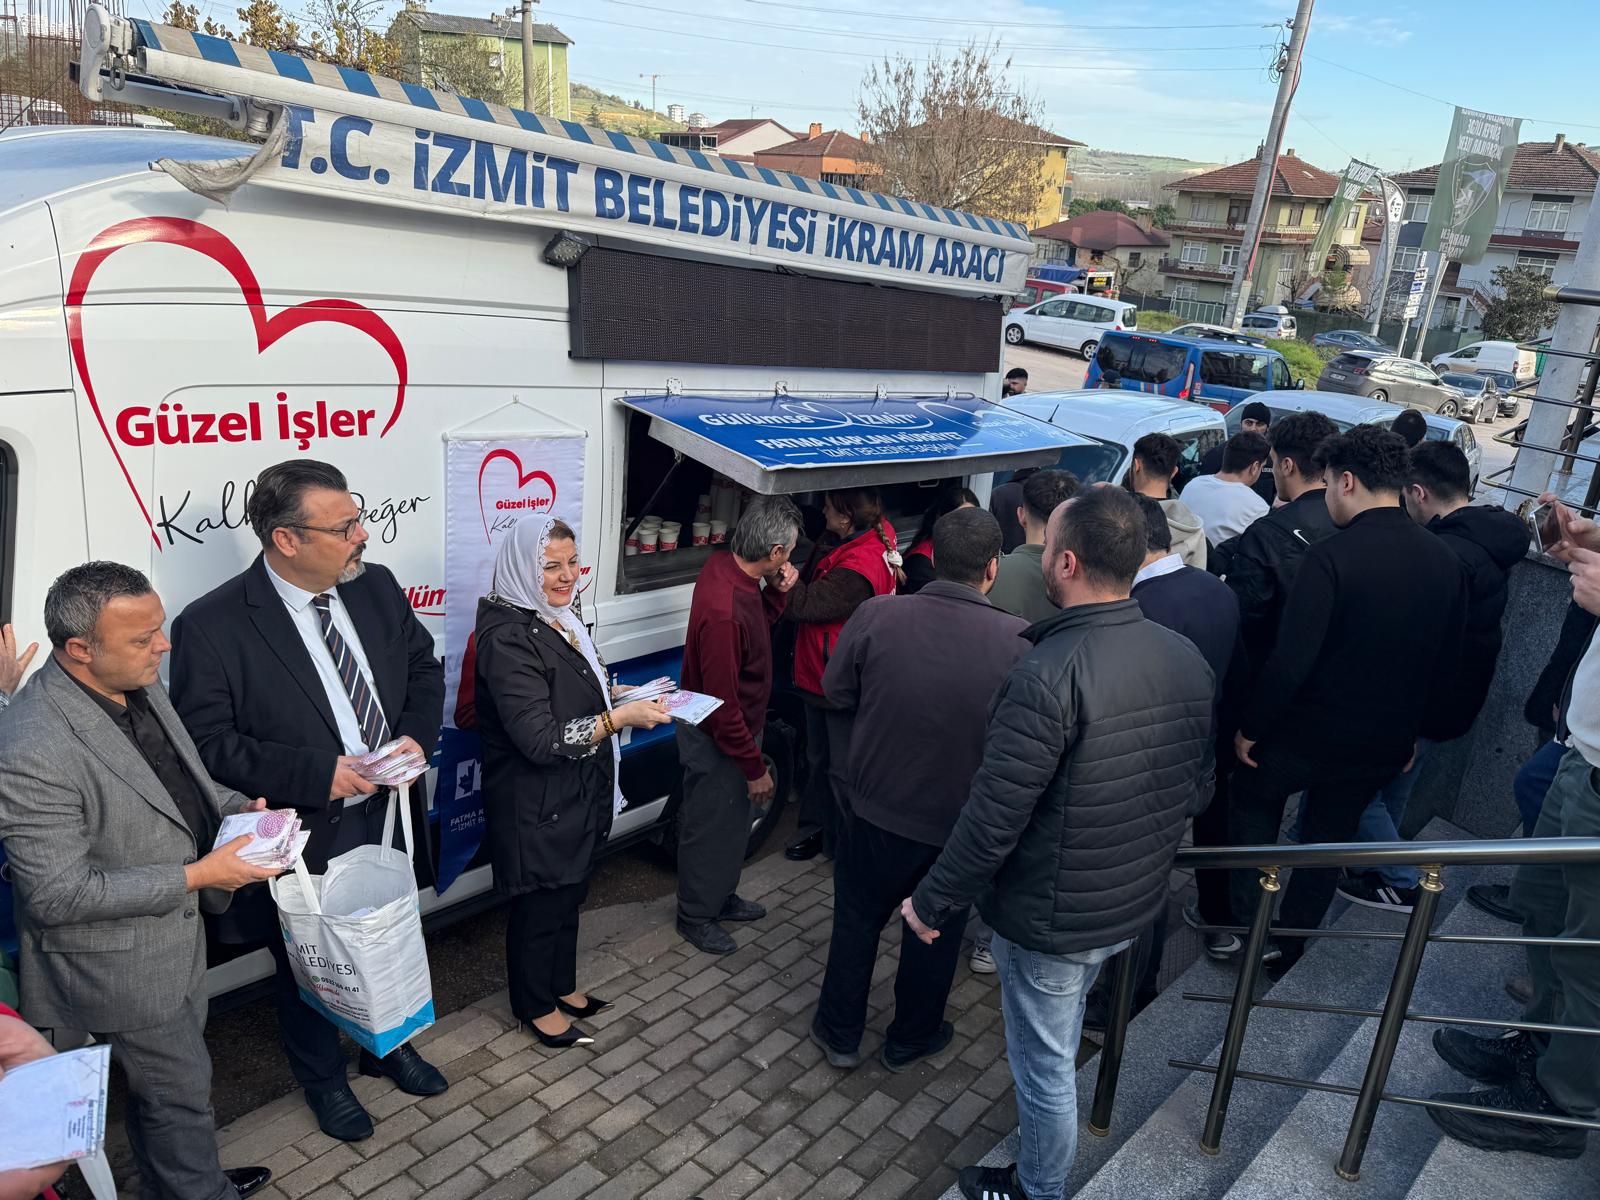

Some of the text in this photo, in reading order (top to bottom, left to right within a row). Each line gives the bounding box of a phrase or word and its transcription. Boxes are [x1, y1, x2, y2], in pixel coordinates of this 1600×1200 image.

[282, 107, 1005, 284] T.C. İZMİT BELEDİYESİ İKRAM ARACI
[115, 392, 376, 451] Güzel İşler
[698, 412, 816, 428] Gülümse
[755, 436, 830, 450] FATMA
[495, 496, 551, 510] Güzel İşler
[450, 811, 476, 827] FATMA
